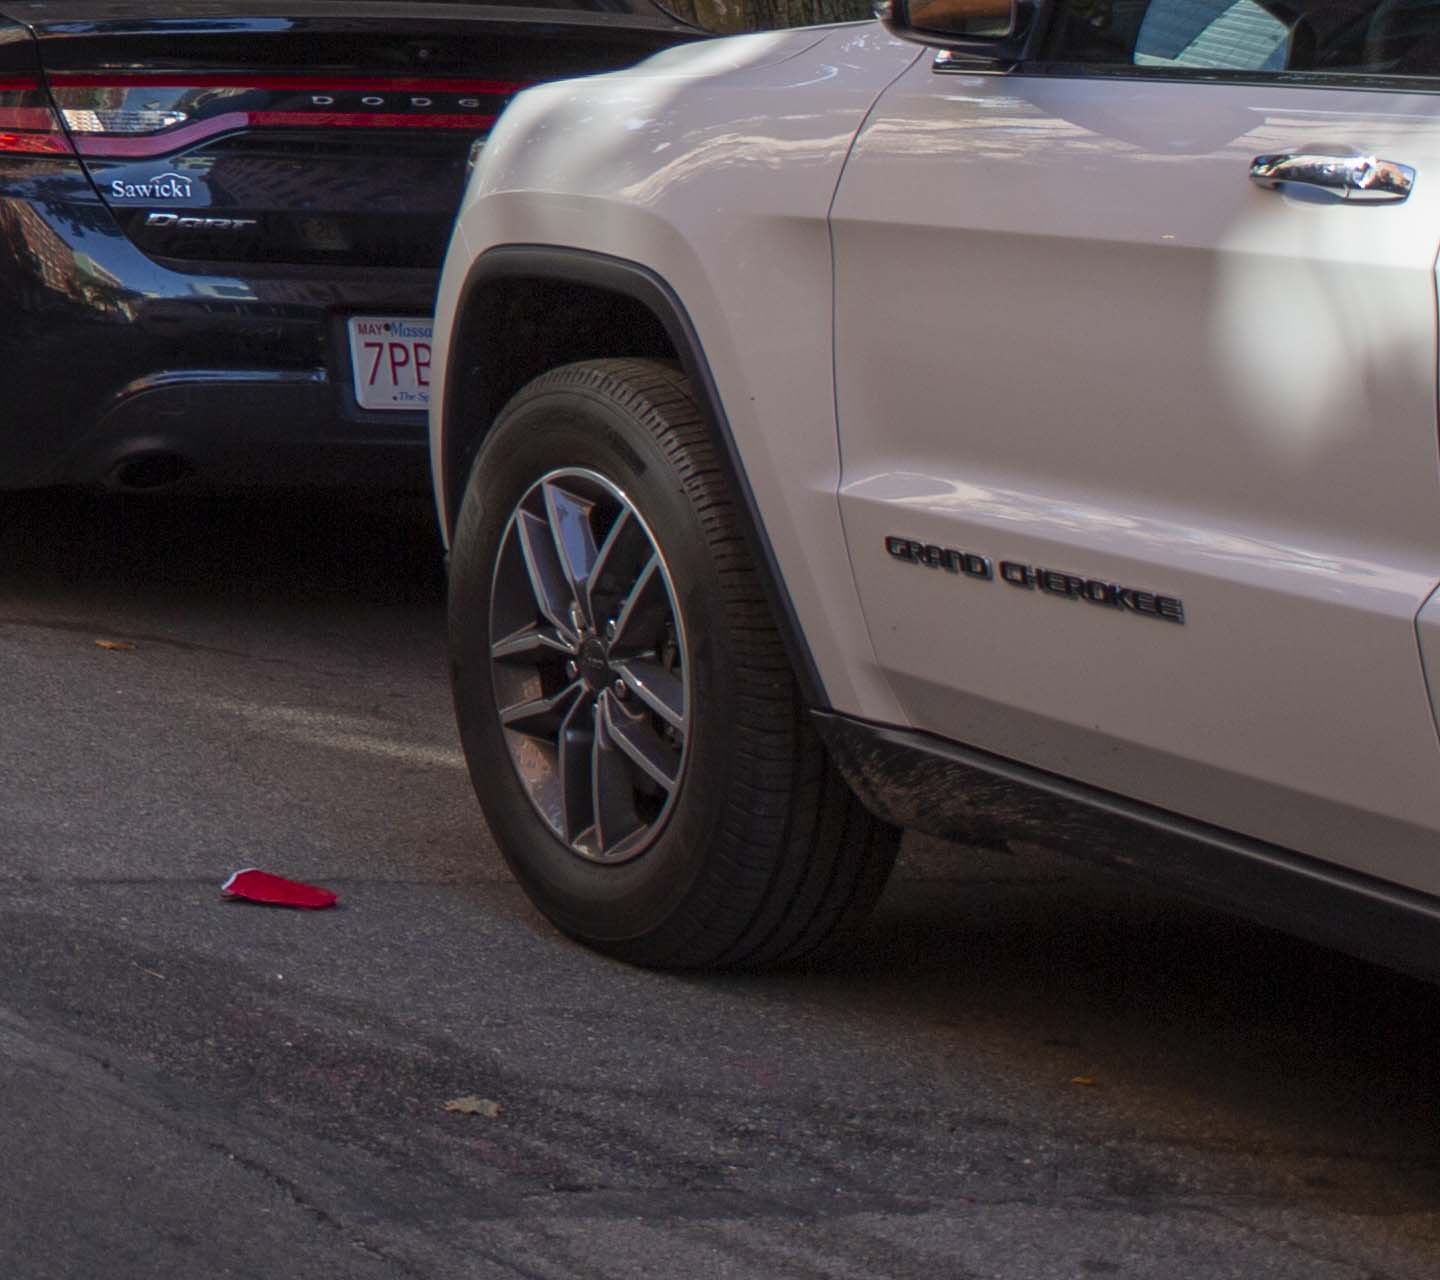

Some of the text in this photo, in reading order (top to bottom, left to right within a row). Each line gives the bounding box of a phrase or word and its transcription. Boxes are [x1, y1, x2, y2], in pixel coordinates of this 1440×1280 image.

[312, 95, 511, 108] DODG
[111, 178, 192, 198] Sawicki
[358, 323, 382, 336] MAY
[399, 391, 417, 401] The
[885, 536, 1185, 625] GRAND CHEROKEE
